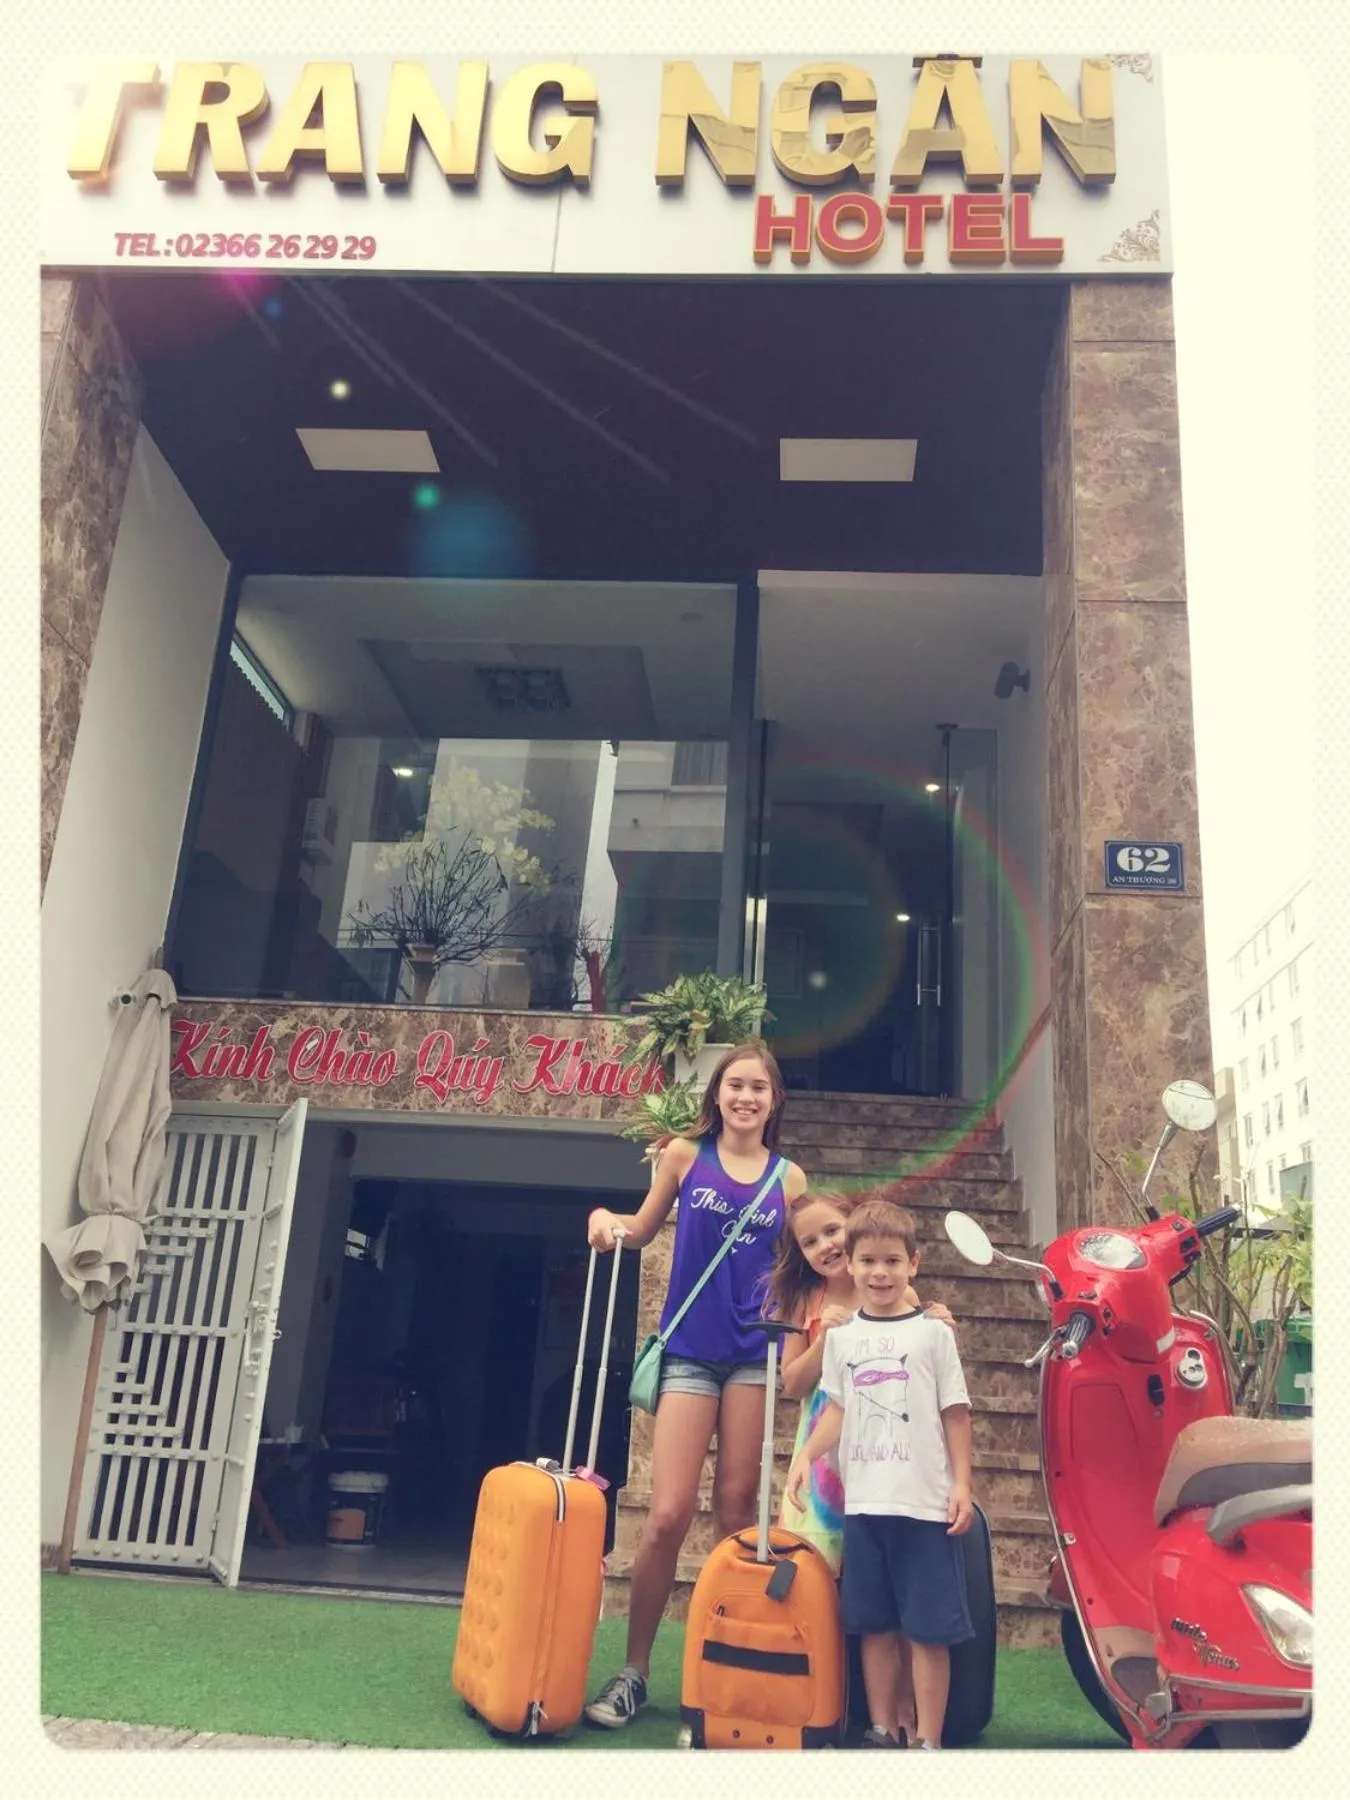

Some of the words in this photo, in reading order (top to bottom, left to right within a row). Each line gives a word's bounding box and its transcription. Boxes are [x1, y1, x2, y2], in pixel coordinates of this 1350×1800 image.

[62, 60, 600, 187] TRANG
[265, 234, 301, 258] 26
[303, 235, 338, 259] 29
[341, 235, 377, 260] 29
[753, 191, 1065, 265] HOTEL
[1116, 846, 1171, 873] 62
[171, 1019, 276, 1081] Kính
[287, 1026, 399, 1087] Chào
[414, 1030, 505, 1105] Quý
[690, 1187, 734, 1215] This
